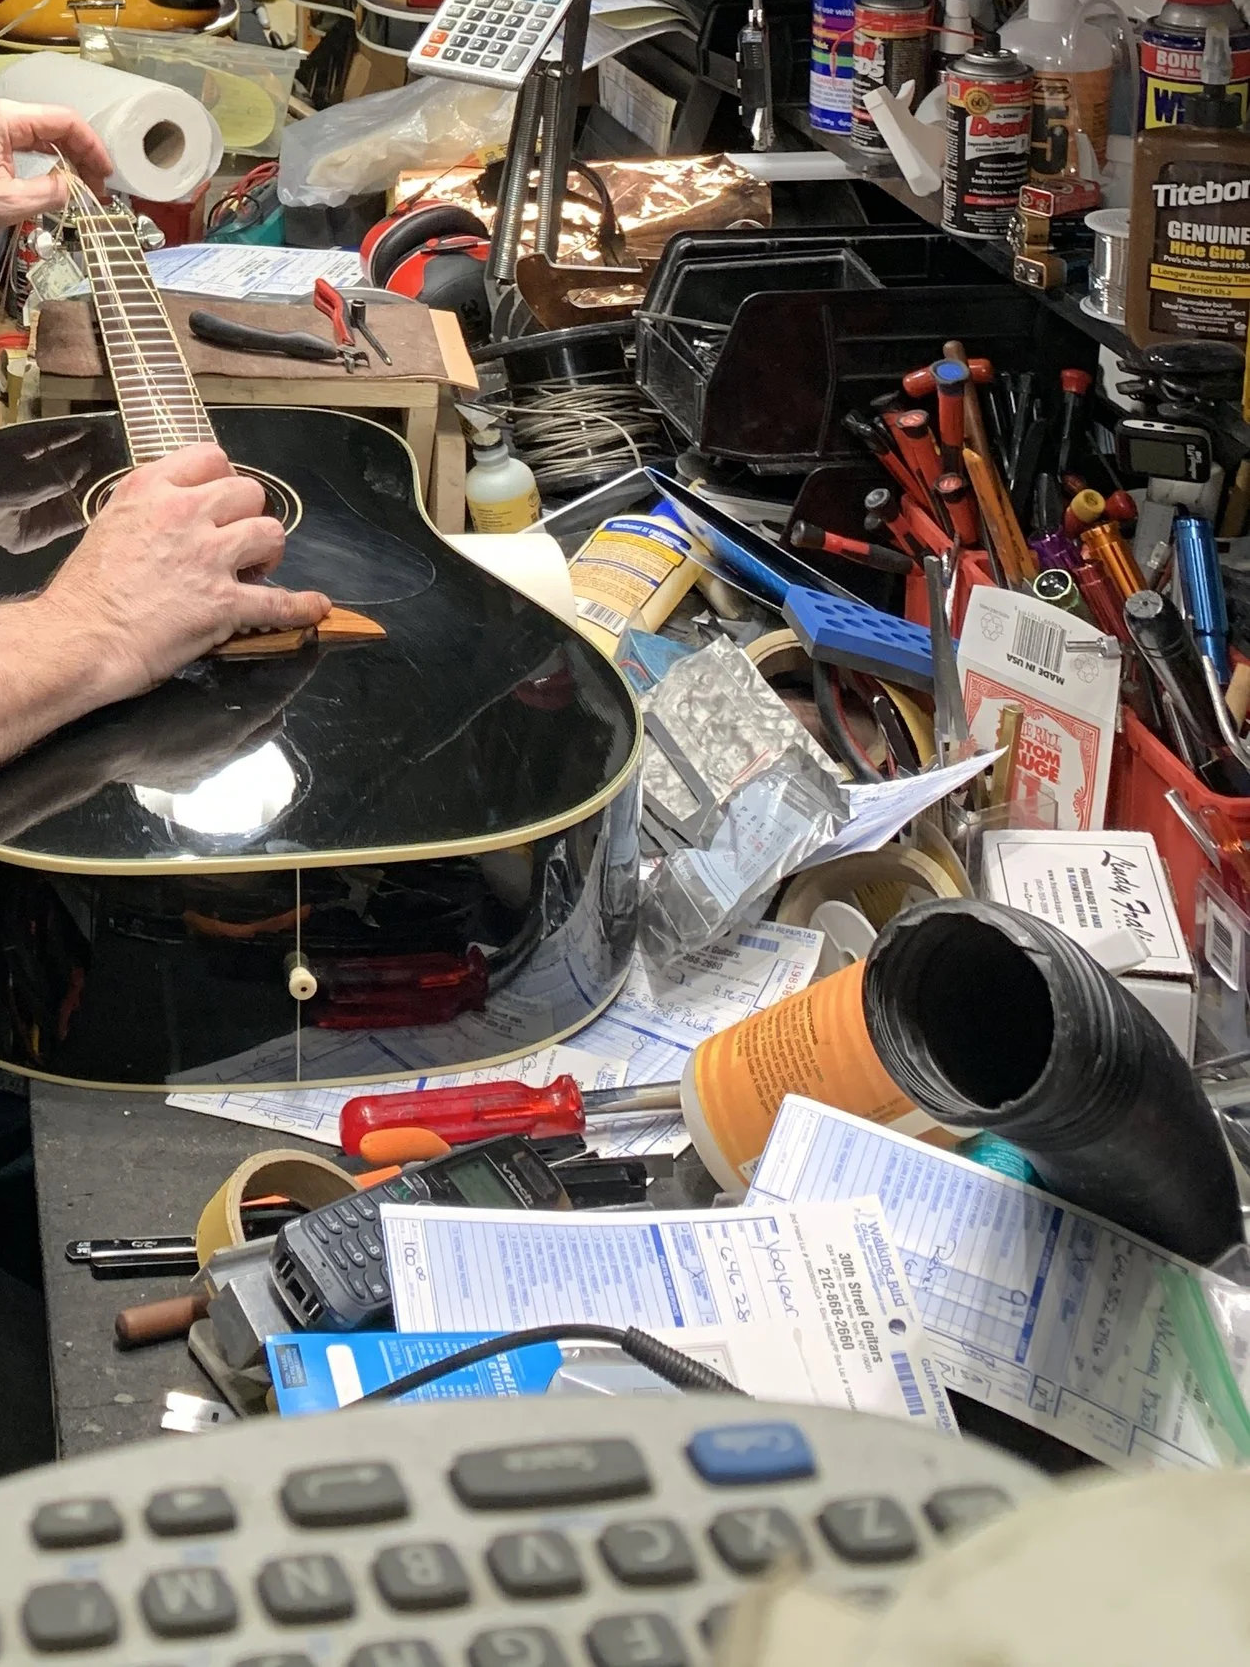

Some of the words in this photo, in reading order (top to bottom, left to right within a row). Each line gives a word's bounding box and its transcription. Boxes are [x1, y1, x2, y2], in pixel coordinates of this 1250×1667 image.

[835, 7, 854, 17] with
[1167, 220, 1250, 246] GENUINE
[1170, 240, 1206, 258] Hide
[1208, 245, 1246, 261] Glue
[1182, 257, 1208, 268] Choice
[1210, 260, 1230, 269] Since
[1157, 267, 1188, 279] Longer
[1190, 272, 1232, 284] Assembly
[1179, 284, 1212, 295] Interior
[1213, 301, 1232, 310] bond
[1006, 652, 1024, 669] USA
[1025, 662, 1036, 673] IN
[1038, 668, 1065, 686] MADE
[1079, 867, 1092, 890] PROUDLY
[1101, 849, 1141, 896] Lindy
[1067, 874, 1082, 903] RICHMOND
[1085, 890, 1097, 906] MADE
[1074, 904, 1088, 928] VIRGINIA
[1089, 906, 1098, 914] BY
[1110, 898, 1156, 942] Frali
[775, 925, 801, 938] REPAIR
[802, 929, 818, 940] TAG
[1091, 914, 1102, 929] HAND
[859, 1223, 870, 1241] CALL
[720, 1245, 736, 1286] 646
[868, 1221, 895, 1277] Walking
[888, 1282, 909, 1309] Bird
[838, 1278, 848, 1300] Street
[666, 1289, 679, 1319] SERVICE
[817, 1267, 854, 1351] 212-868-2660
[839, 1252, 855, 1278] 30th
[848, 1281, 869, 1317] Street
[861, 1320, 883, 1364] Guitars
[921, 1357, 939, 1396] GUITAR
[519, 1538, 559, 1576] V
[634, 1527, 671, 1563] C
[738, 1515, 778, 1551] X
[860, 1504, 894, 1537] Z
[159, 1575, 210, 1615] M
[281, 1561, 330, 1601] N
[402, 1547, 444, 1584] B
[629, 1618, 664, 1661] F
